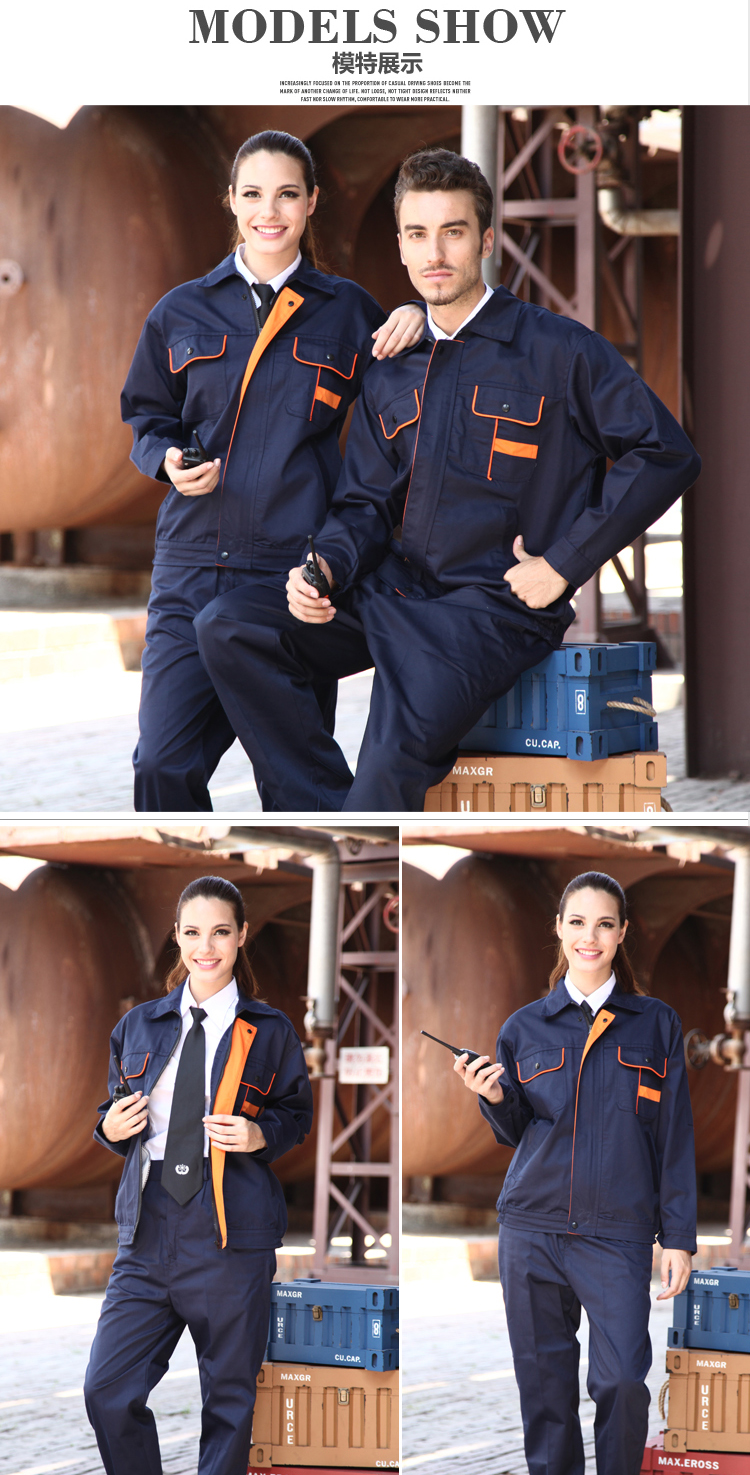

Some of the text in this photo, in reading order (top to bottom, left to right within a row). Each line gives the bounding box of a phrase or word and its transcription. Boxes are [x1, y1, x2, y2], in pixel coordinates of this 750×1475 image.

[525, 738, 561, 750] CU.CAP.
[452, 766, 494, 777] MAXGR
[693, 1277, 720, 1287] MAXGR
[276, 1290, 303, 1299] MAXGR
[693, 1304, 701, 1326] URCE
[276, 1317, 284, 1339] URCE
[334, 1354, 362, 1363] CU.CAP.
[696, 1359, 728, 1369] MAXGR
[280, 1373, 312, 1382] MAXGR
[701, 1384, 710, 1431] URCE
[286, 1398, 294, 1445] URCE
[657, 1456, 720, 1470] MAX.EROSS
